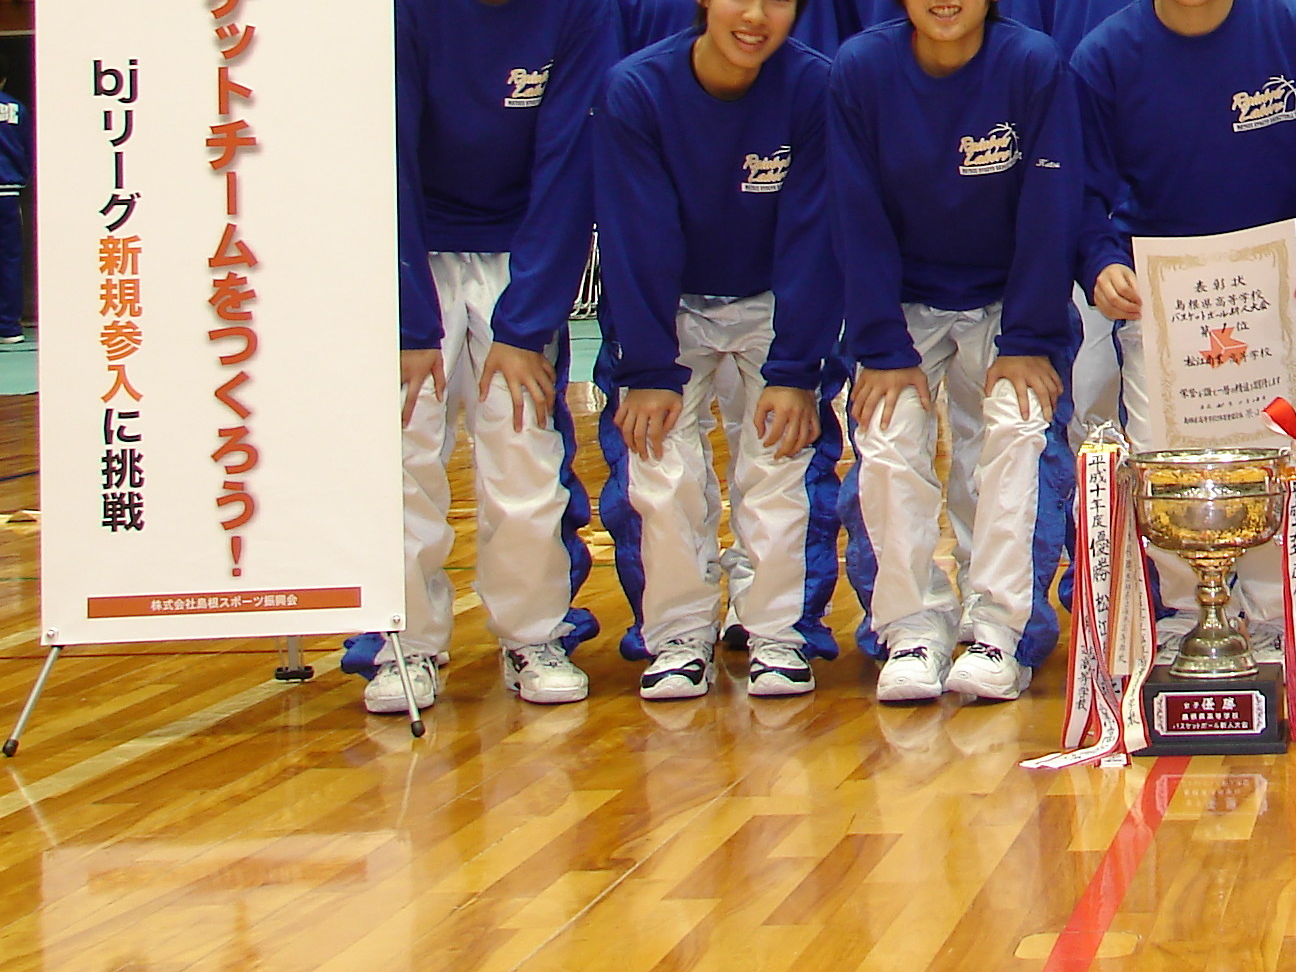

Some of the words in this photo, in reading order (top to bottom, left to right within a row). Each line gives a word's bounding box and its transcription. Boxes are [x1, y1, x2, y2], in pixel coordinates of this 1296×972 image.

[1194, 275, 1248, 293] 表彰状
[93, 58, 145, 533] bjリーグ新規参入に挑戦
[150, 593, 298, 611] 株式会社島根スポーツ振興会
